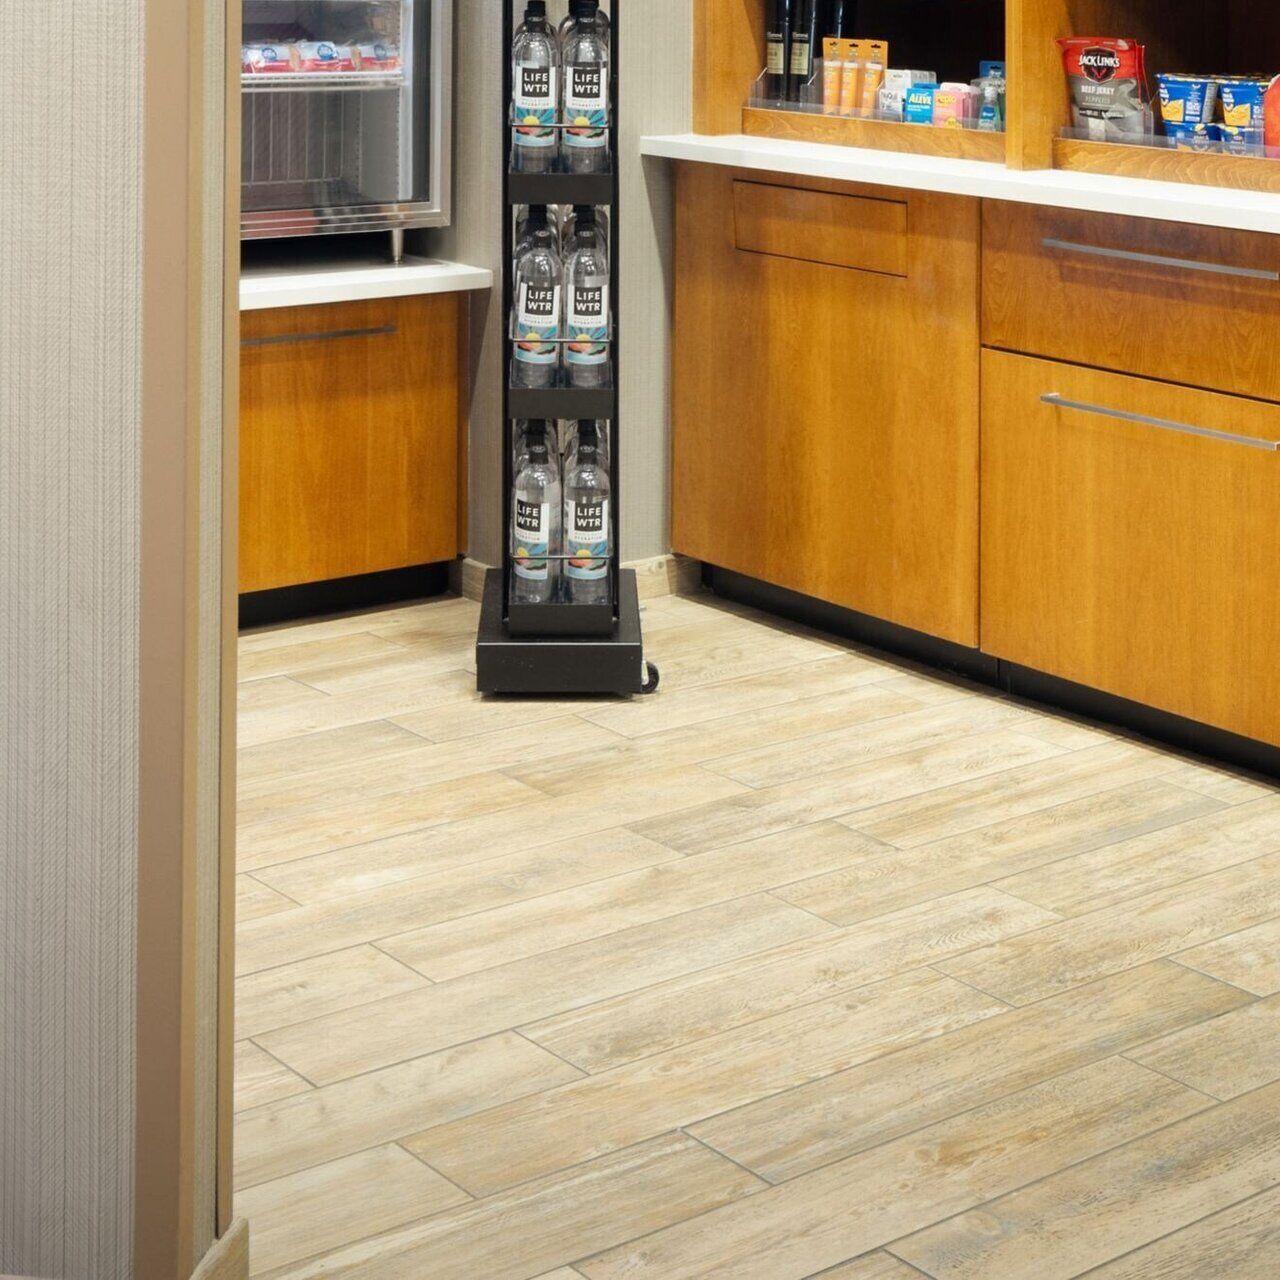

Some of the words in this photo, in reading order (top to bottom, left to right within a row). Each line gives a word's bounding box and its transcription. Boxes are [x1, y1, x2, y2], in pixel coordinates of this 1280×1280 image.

[1078, 54, 1098, 67] JACK
[523, 72, 548, 82] LIFE
[574, 73, 599, 83] LIFE
[523, 83, 548, 93] WTR
[574, 84, 599, 94] WTR
[528, 289, 553, 300] LIFE
[576, 291, 600, 300] LIFE
[527, 300, 552, 311] WTR
[575, 302, 600, 311] WTR
[517, 504, 539, 517] LIFE
[577, 506, 601, 517] LIFE
[517, 514, 539, 528] WTR
[576, 517, 601, 528] WTR
